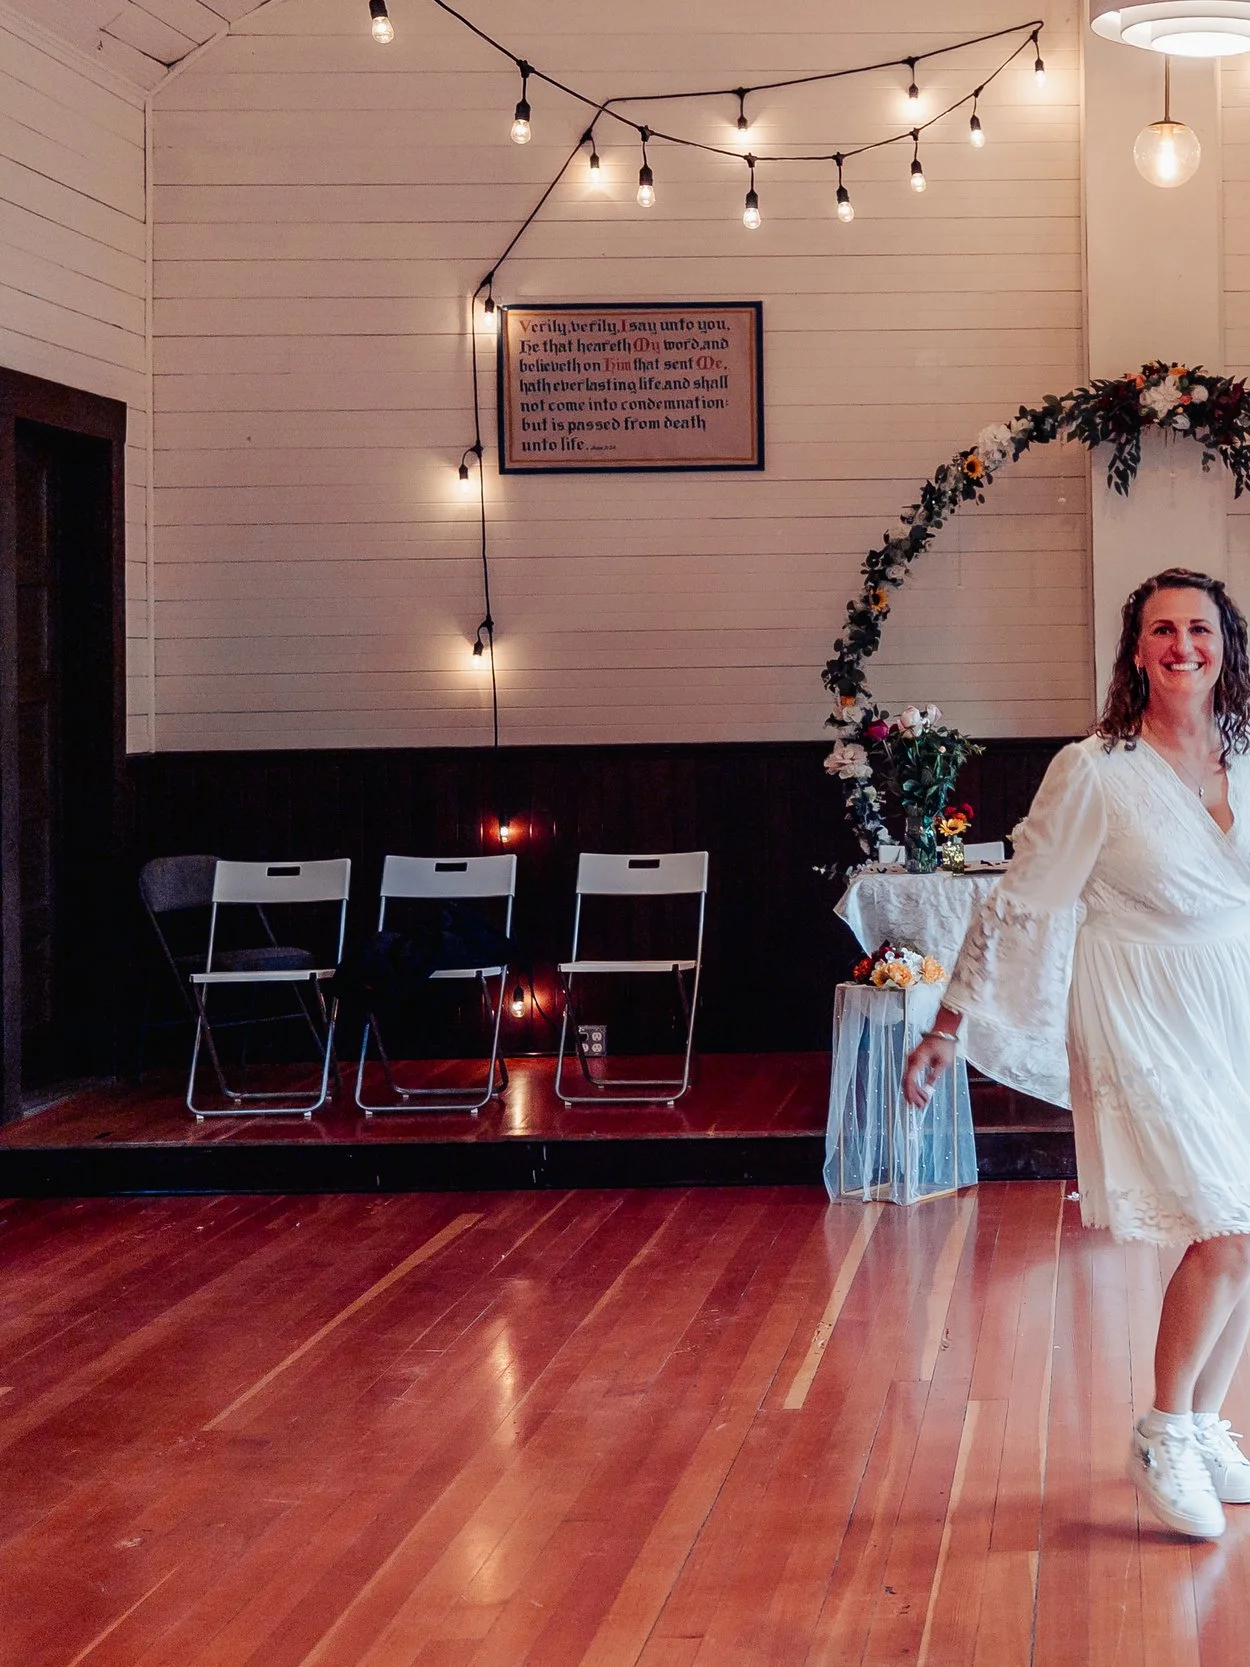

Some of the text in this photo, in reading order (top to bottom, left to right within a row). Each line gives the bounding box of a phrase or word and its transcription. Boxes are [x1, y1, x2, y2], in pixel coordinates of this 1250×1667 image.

[629, 321, 657, 334] say
[661, 319, 694, 332] unto
[519, 340, 541, 354] He
[544, 339, 574, 355] that
[578, 338, 631, 354] heareth
[633, 338, 661, 353] My
[703, 339, 729, 349] and
[519, 359, 581, 374] believeth
[584, 362, 600, 371] on
[603, 358, 631, 373] Him
[633, 357, 659, 373] that
[664, 357, 694, 370] sent
[520, 378, 551, 395] hath
[664, 376, 690, 390] and
[693, 375, 728, 390] shall
[521, 399, 545, 412] not
[549, 401, 585, 412] come
[589, 398, 617, 411] into
[522, 415, 706, 434] but is passed from death
[522, 438, 557, 452] unto
